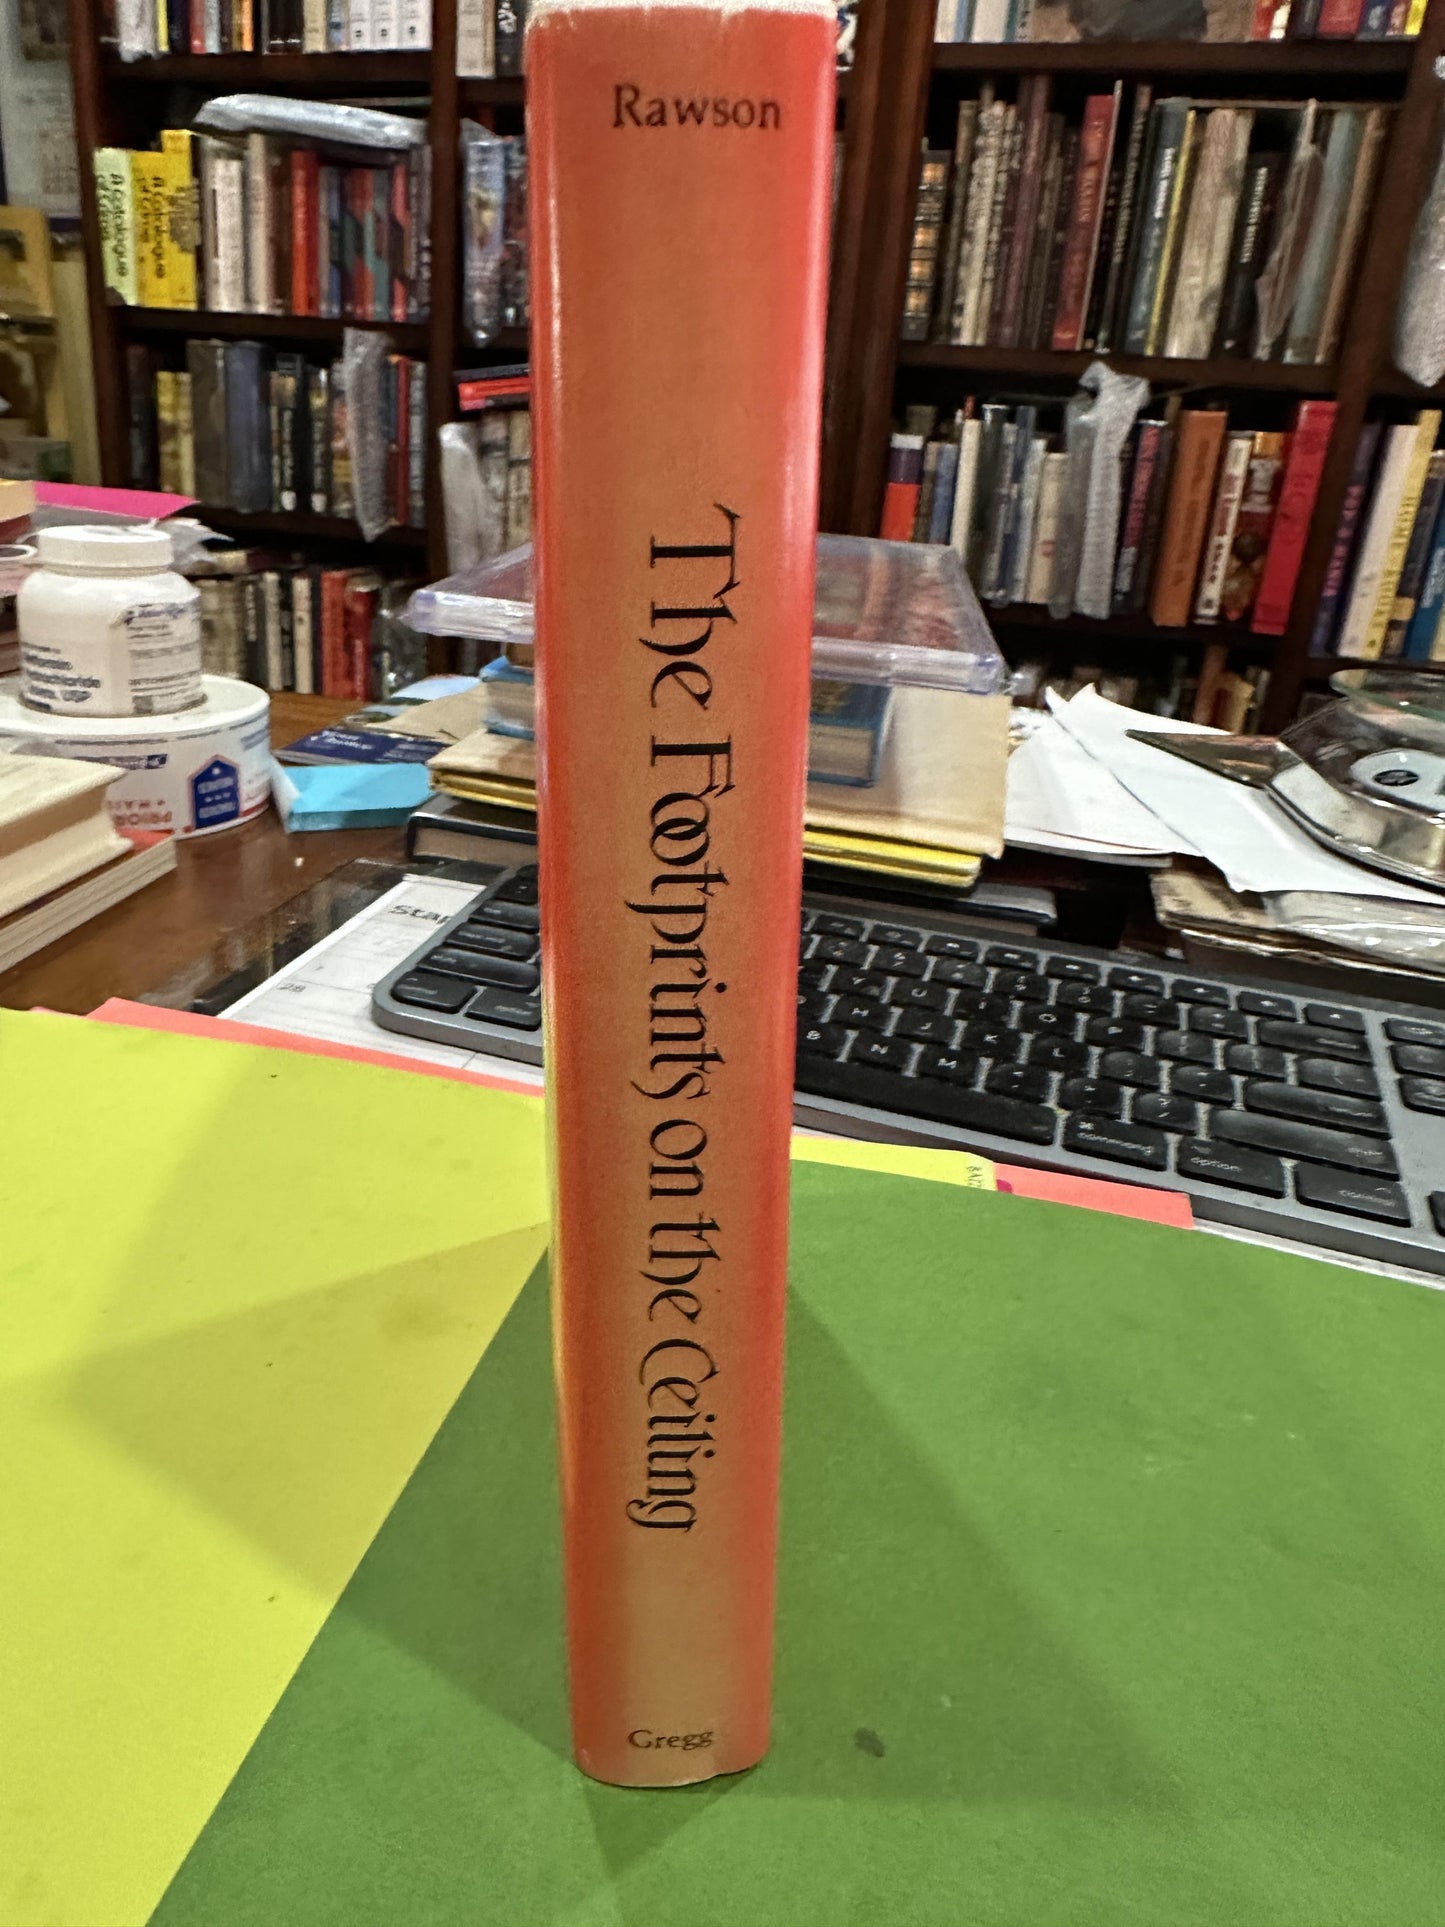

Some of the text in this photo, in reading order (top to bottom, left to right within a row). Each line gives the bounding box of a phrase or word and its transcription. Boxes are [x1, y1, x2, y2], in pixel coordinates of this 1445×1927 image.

[613, 82, 781, 129] Rawson
[624, 503, 741, 1533] The Footprints on the Ceiling
[870, 1043, 888, 1054] N
[938, 1057, 957, 1069] M
